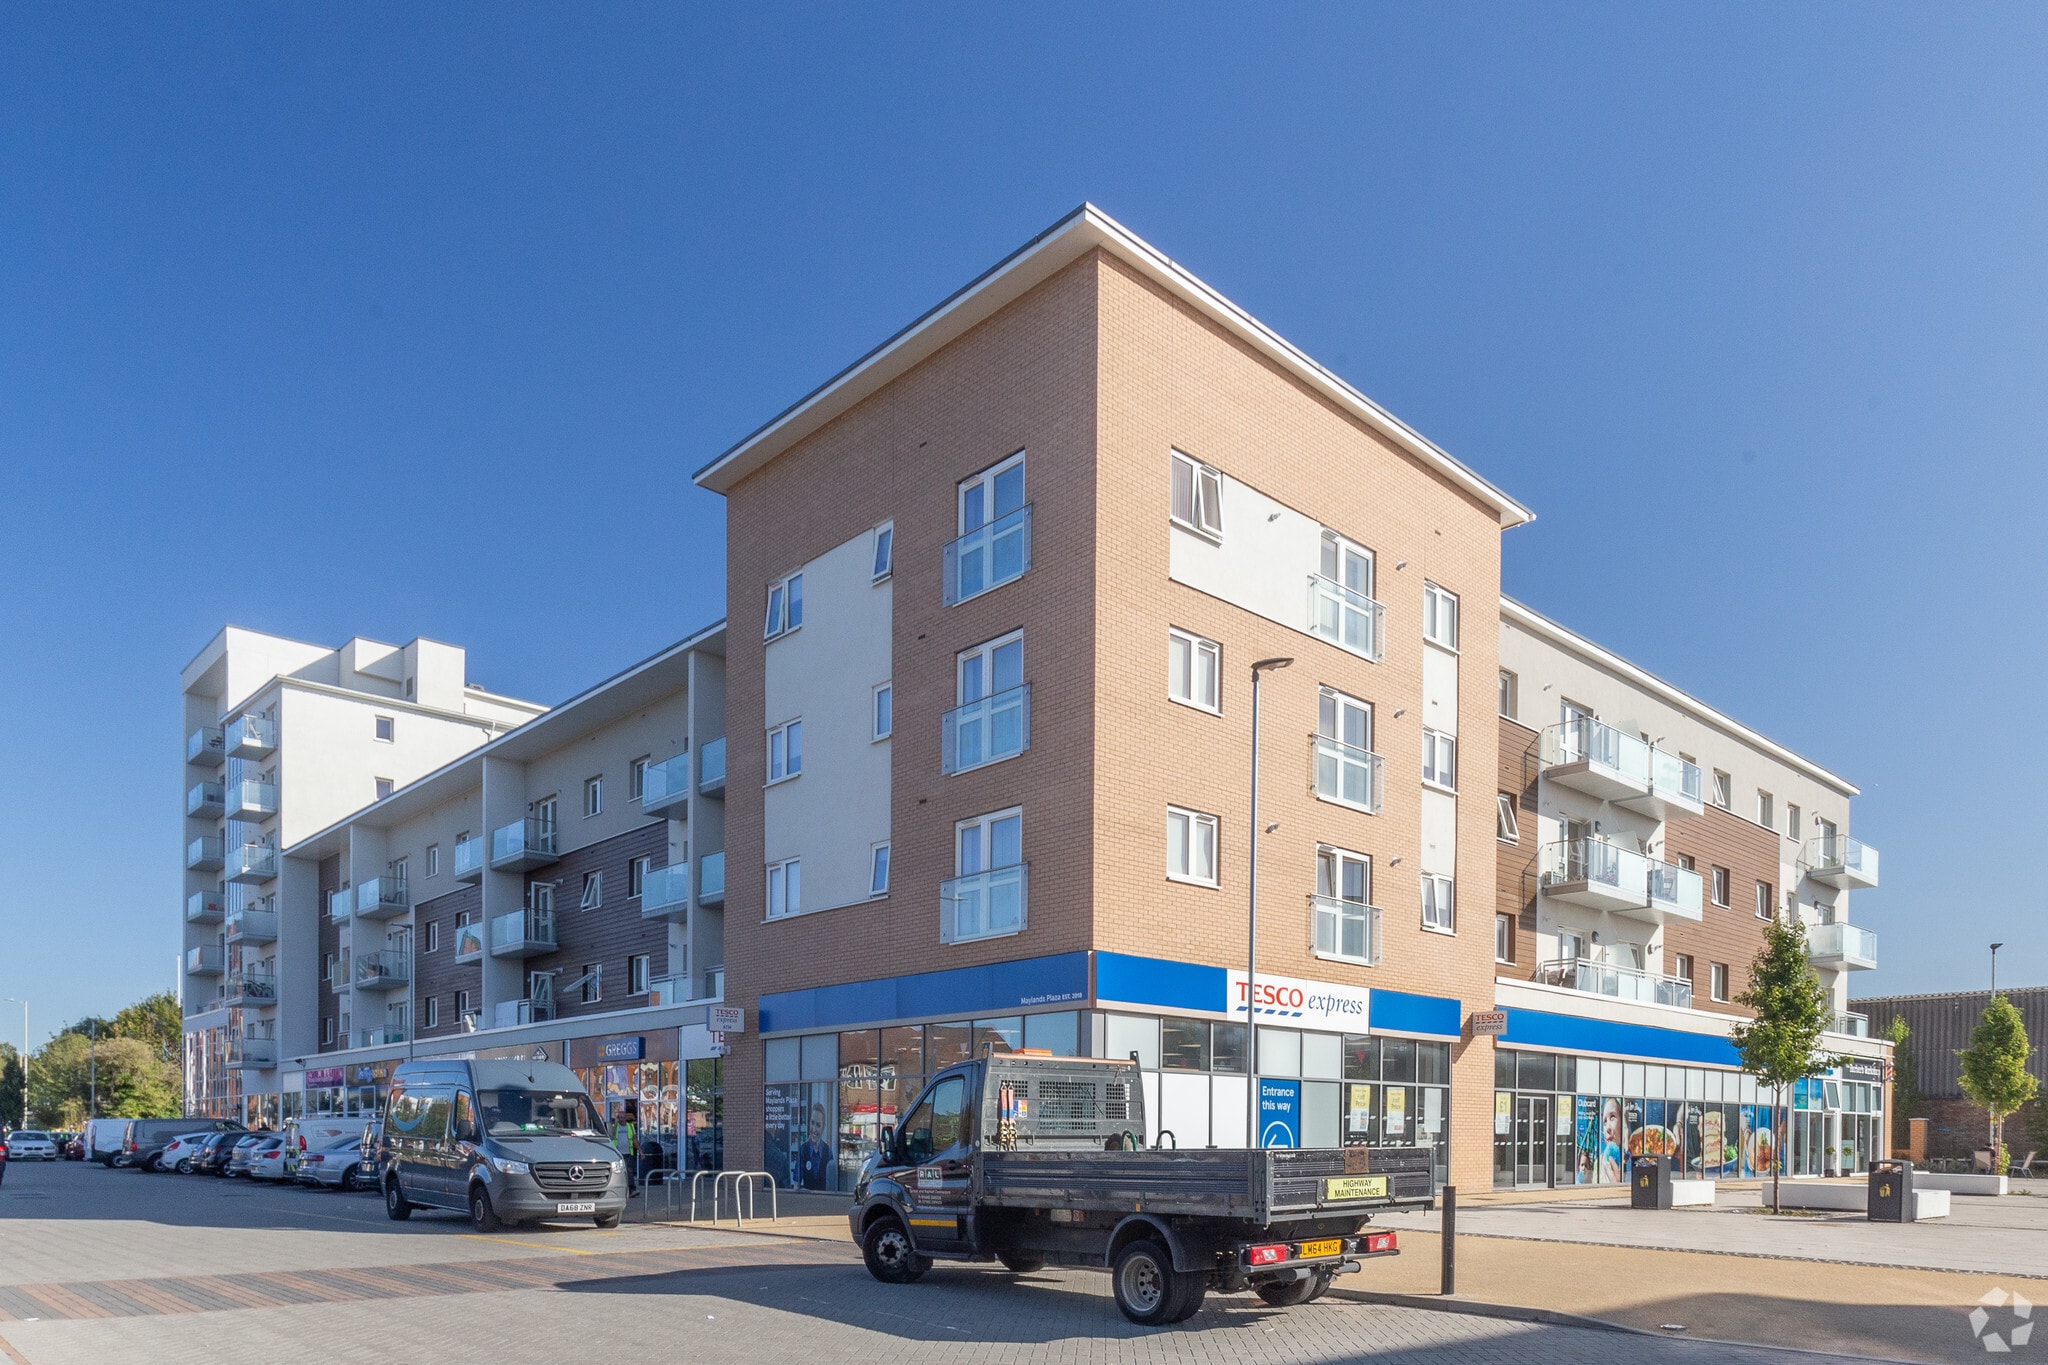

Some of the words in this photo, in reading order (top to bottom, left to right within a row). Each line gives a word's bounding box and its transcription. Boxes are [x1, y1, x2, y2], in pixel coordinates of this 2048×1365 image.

[1021, 995, 1046, 1005] Maylands
[1236, 981, 1303, 1008] TESCO
[1308, 994, 1362, 1017] express
[1475, 1013, 1505, 1021] TESCO
[1476, 1024, 1503, 1032] express
[606, 1042, 637, 1056] GREGGS
[1262, 1085, 1295, 1097] Entrance
[765, 1097, 785, 1105] Maylands
[1262, 1100, 1275, 1110] this
[1277, 1102, 1291, 1113] way
[919, 1170, 940, 1178] RAL
[1343, 1179, 1372, 1188] HIGHWAY
[1334, 1188, 1380, 1198] MAINTENANCE
[1302, 1243, 1322, 1256] LM64
[1323, 1241, 1338, 1253] HKG
